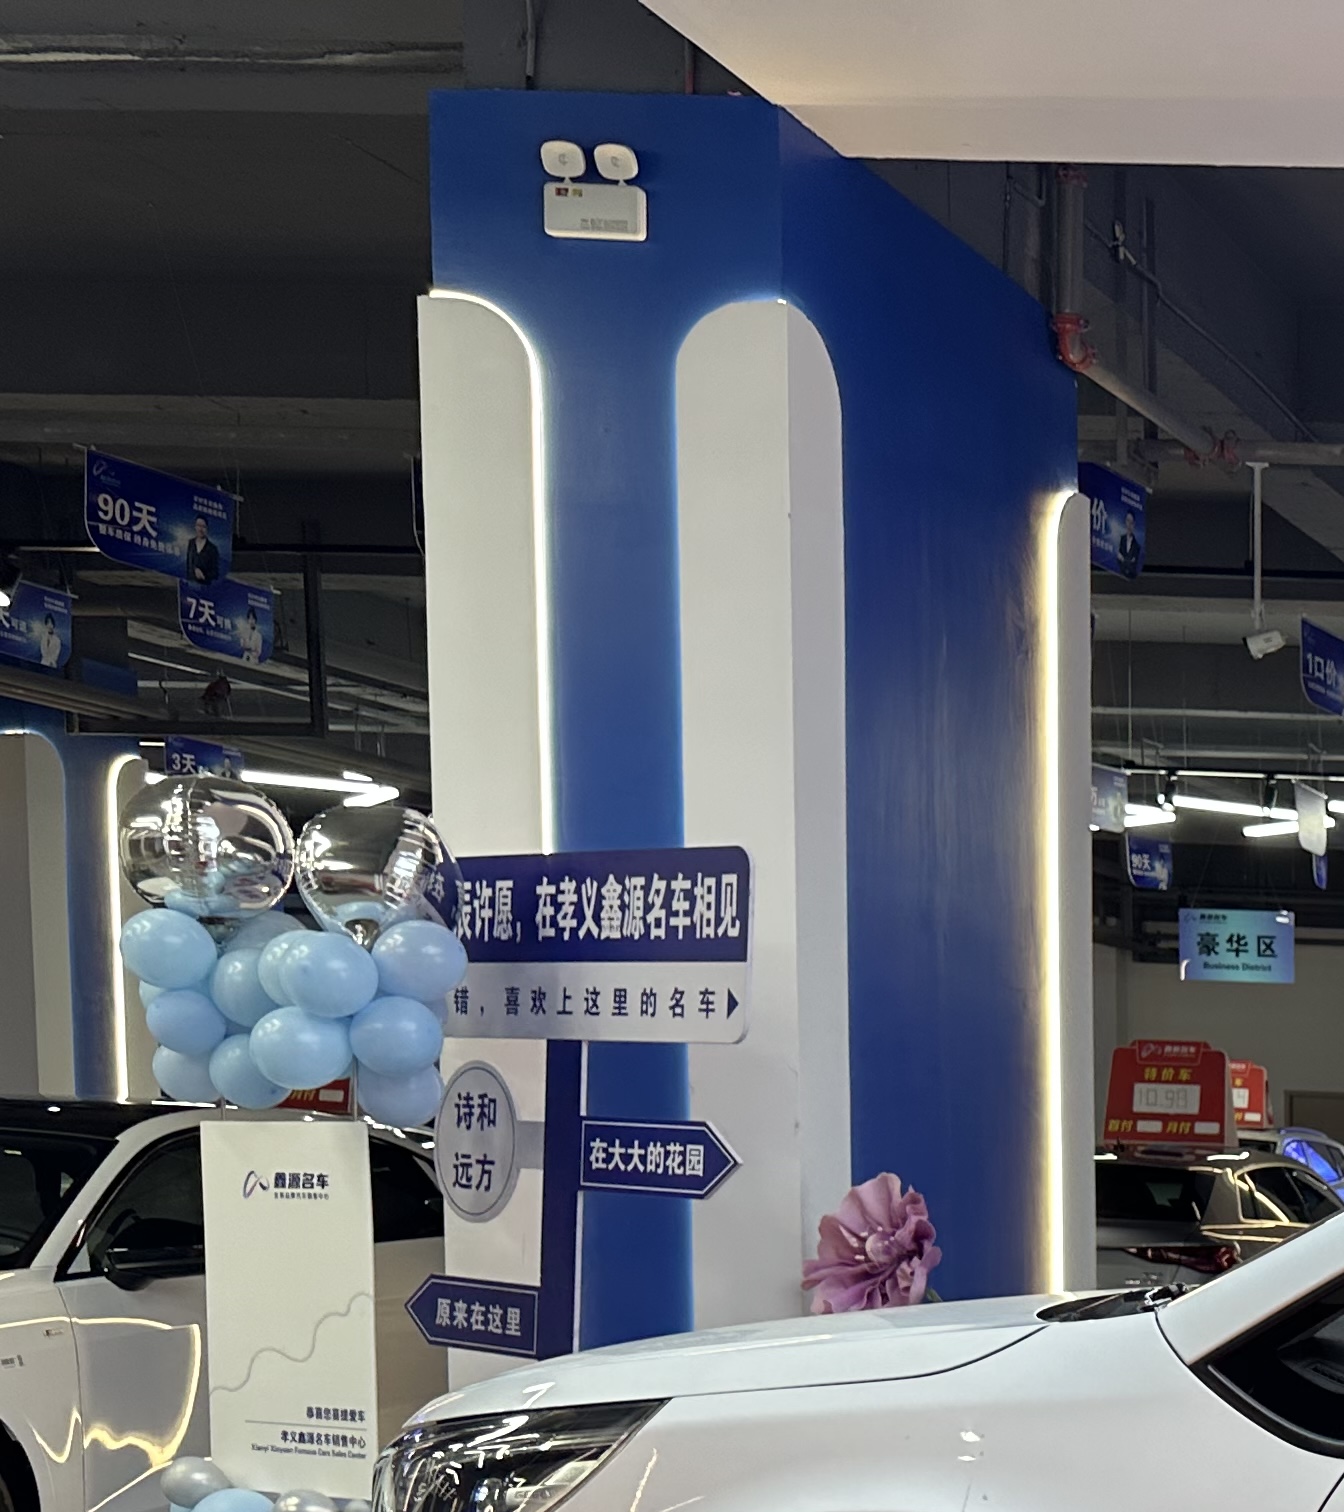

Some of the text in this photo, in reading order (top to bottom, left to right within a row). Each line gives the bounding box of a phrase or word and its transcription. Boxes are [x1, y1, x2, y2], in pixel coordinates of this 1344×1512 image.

[97, 493, 158, 537] 90天
[1306, 653, 1338, 688] 1口价
[172, 753, 196, 774] 3天
[1196, 932, 1278, 957] 豪华区
[454, 1092, 497, 1131] 诗和
[452, 1152, 495, 1193] 远方
[589, 1137, 705, 1177] 在大大的花园
[435, 1297, 522, 1336] 原来在这里
